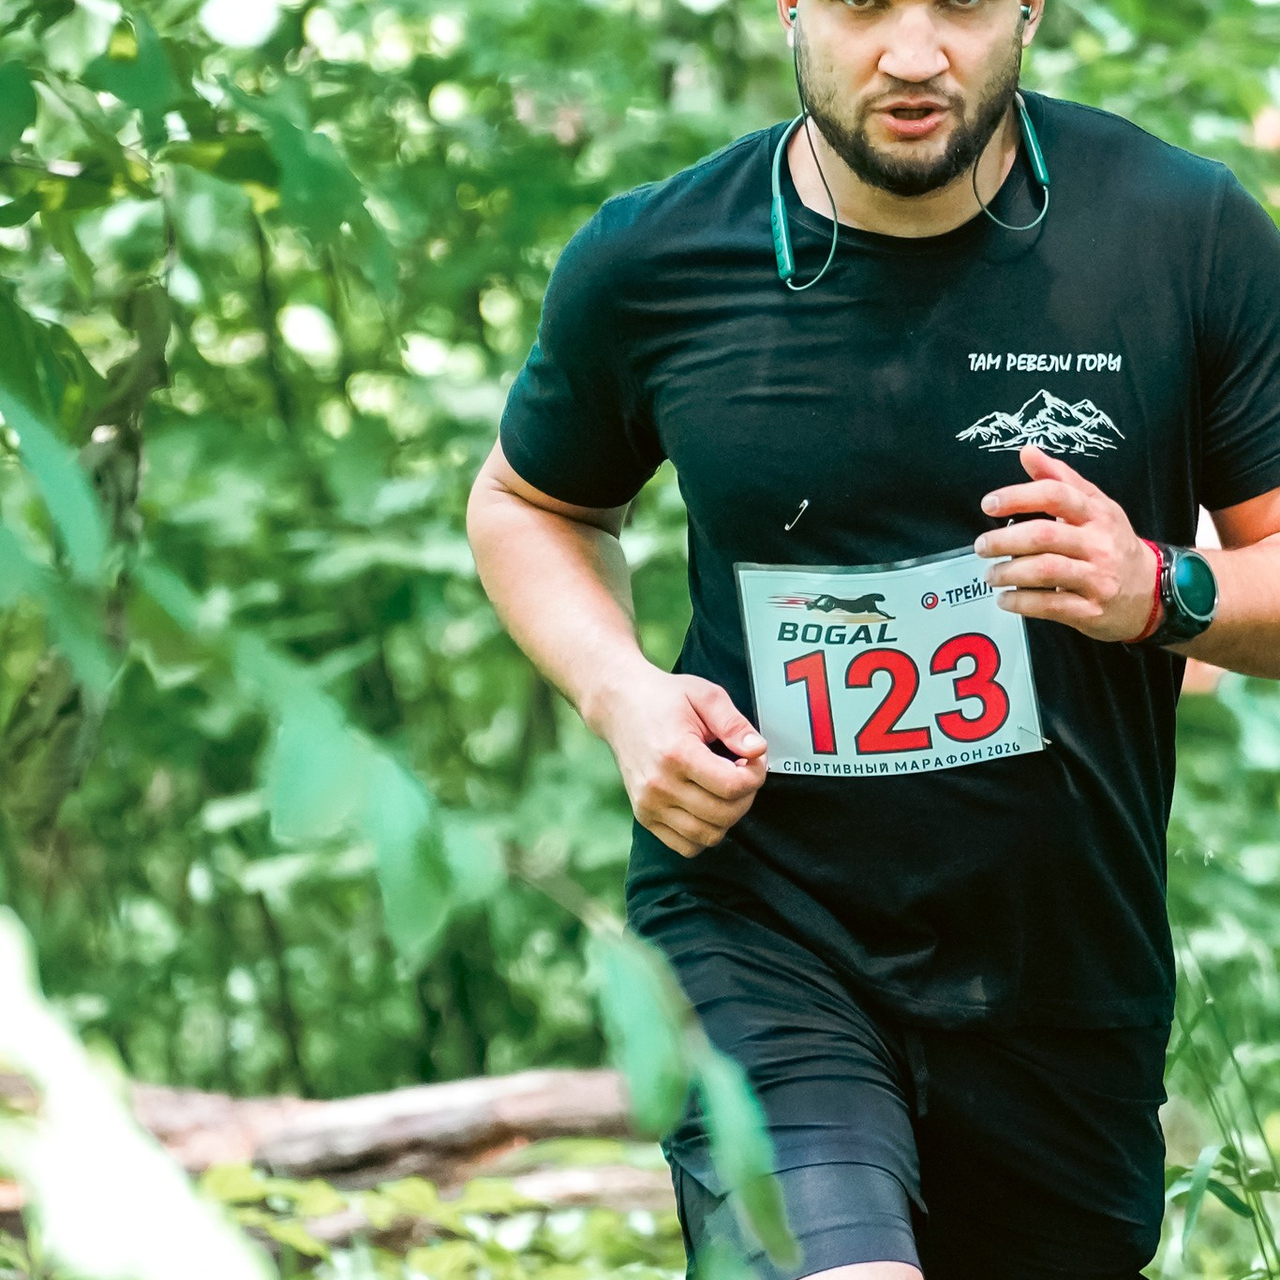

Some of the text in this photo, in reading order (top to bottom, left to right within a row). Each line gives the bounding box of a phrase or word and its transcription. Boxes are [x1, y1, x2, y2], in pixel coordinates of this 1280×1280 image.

[968, 353, 1122, 372] ТАМ РЕВЕЛИ ГОРЫ
[777, 622, 898, 645] BOGAL
[783, 632, 1010, 755] 123
[783, 742, 1021, 774] СПОРТИВНЫЙ МАРАФОН 2026
